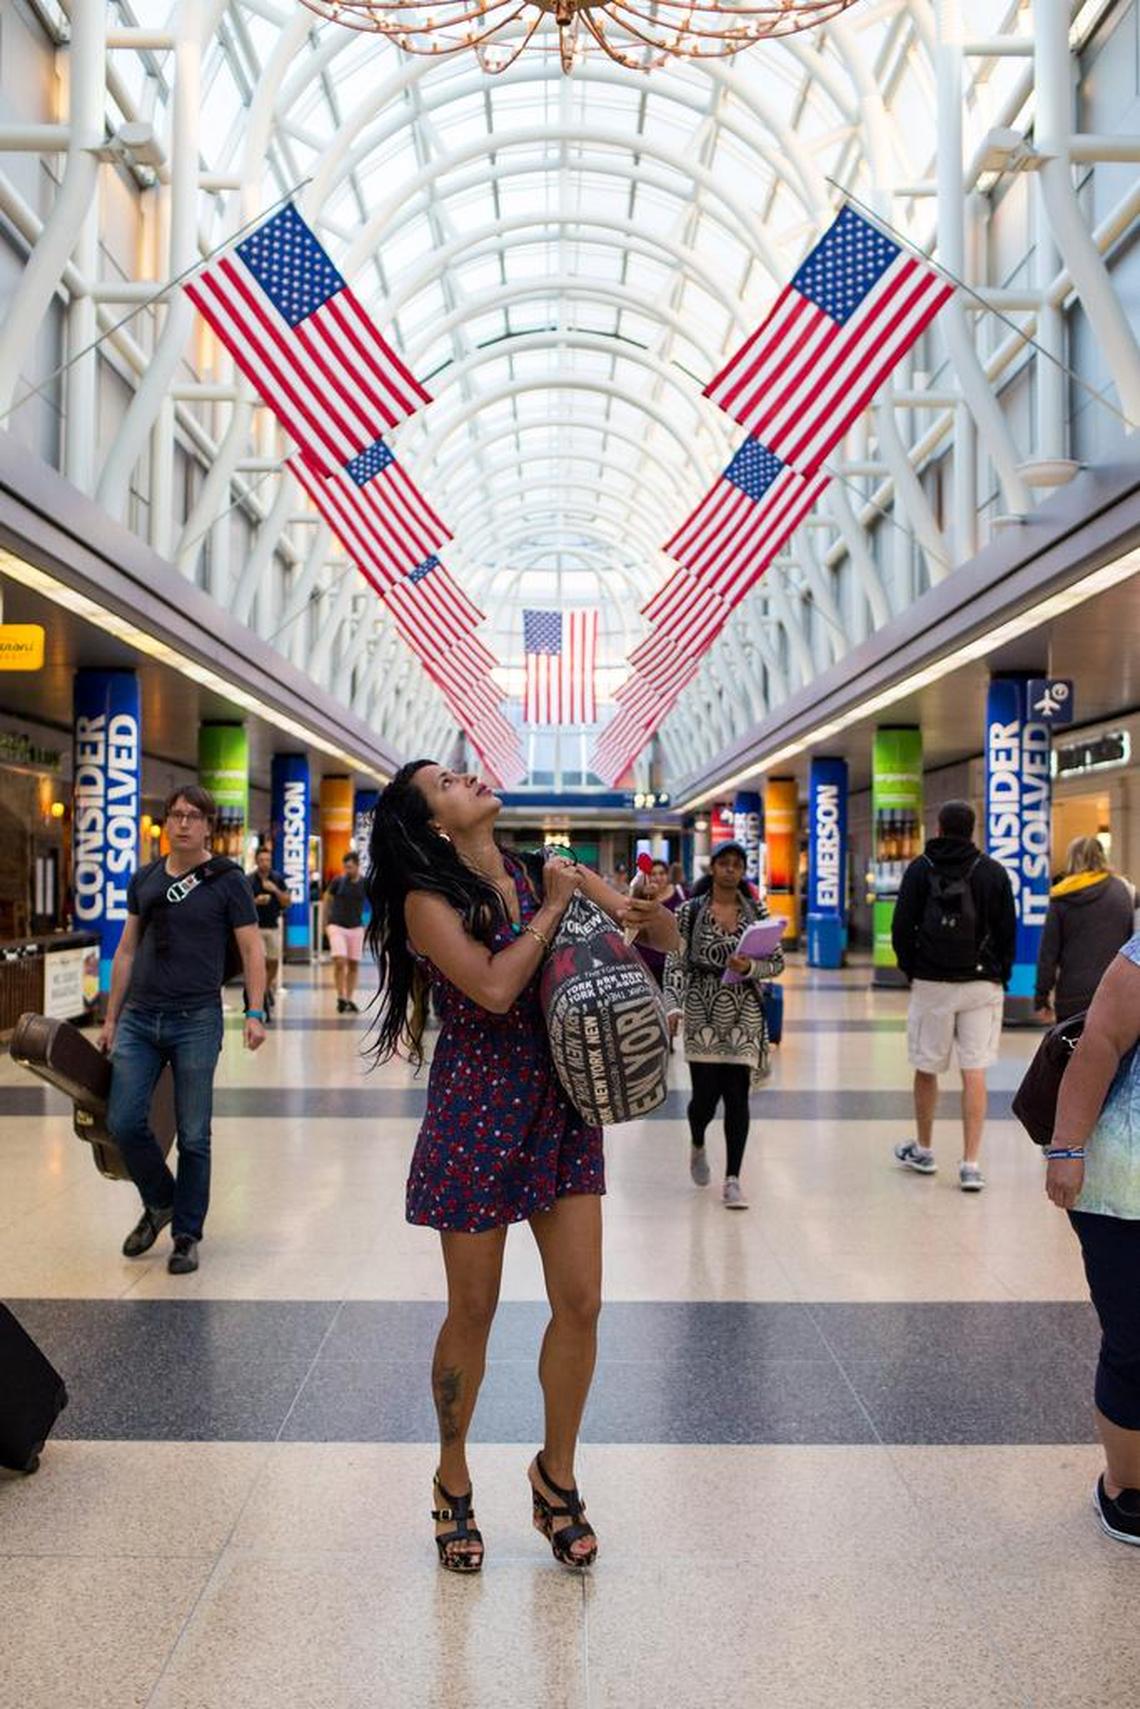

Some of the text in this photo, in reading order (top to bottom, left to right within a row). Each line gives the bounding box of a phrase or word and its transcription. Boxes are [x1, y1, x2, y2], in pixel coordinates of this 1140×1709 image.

[75, 715, 105, 920] CONSIDER
[106, 714, 137, 920] IT SOLVED
[283, 782, 306, 903] EMERSON
[816, 785, 840, 906] EMERSON
[988, 720, 1020, 918] NSIDER
[1022, 722, 1050, 925] IT SOLVED
[584, 1015, 600, 1044] NEW
[588, 1049, 604, 1079] YORK
[594, 1079, 609, 1104] NEW
